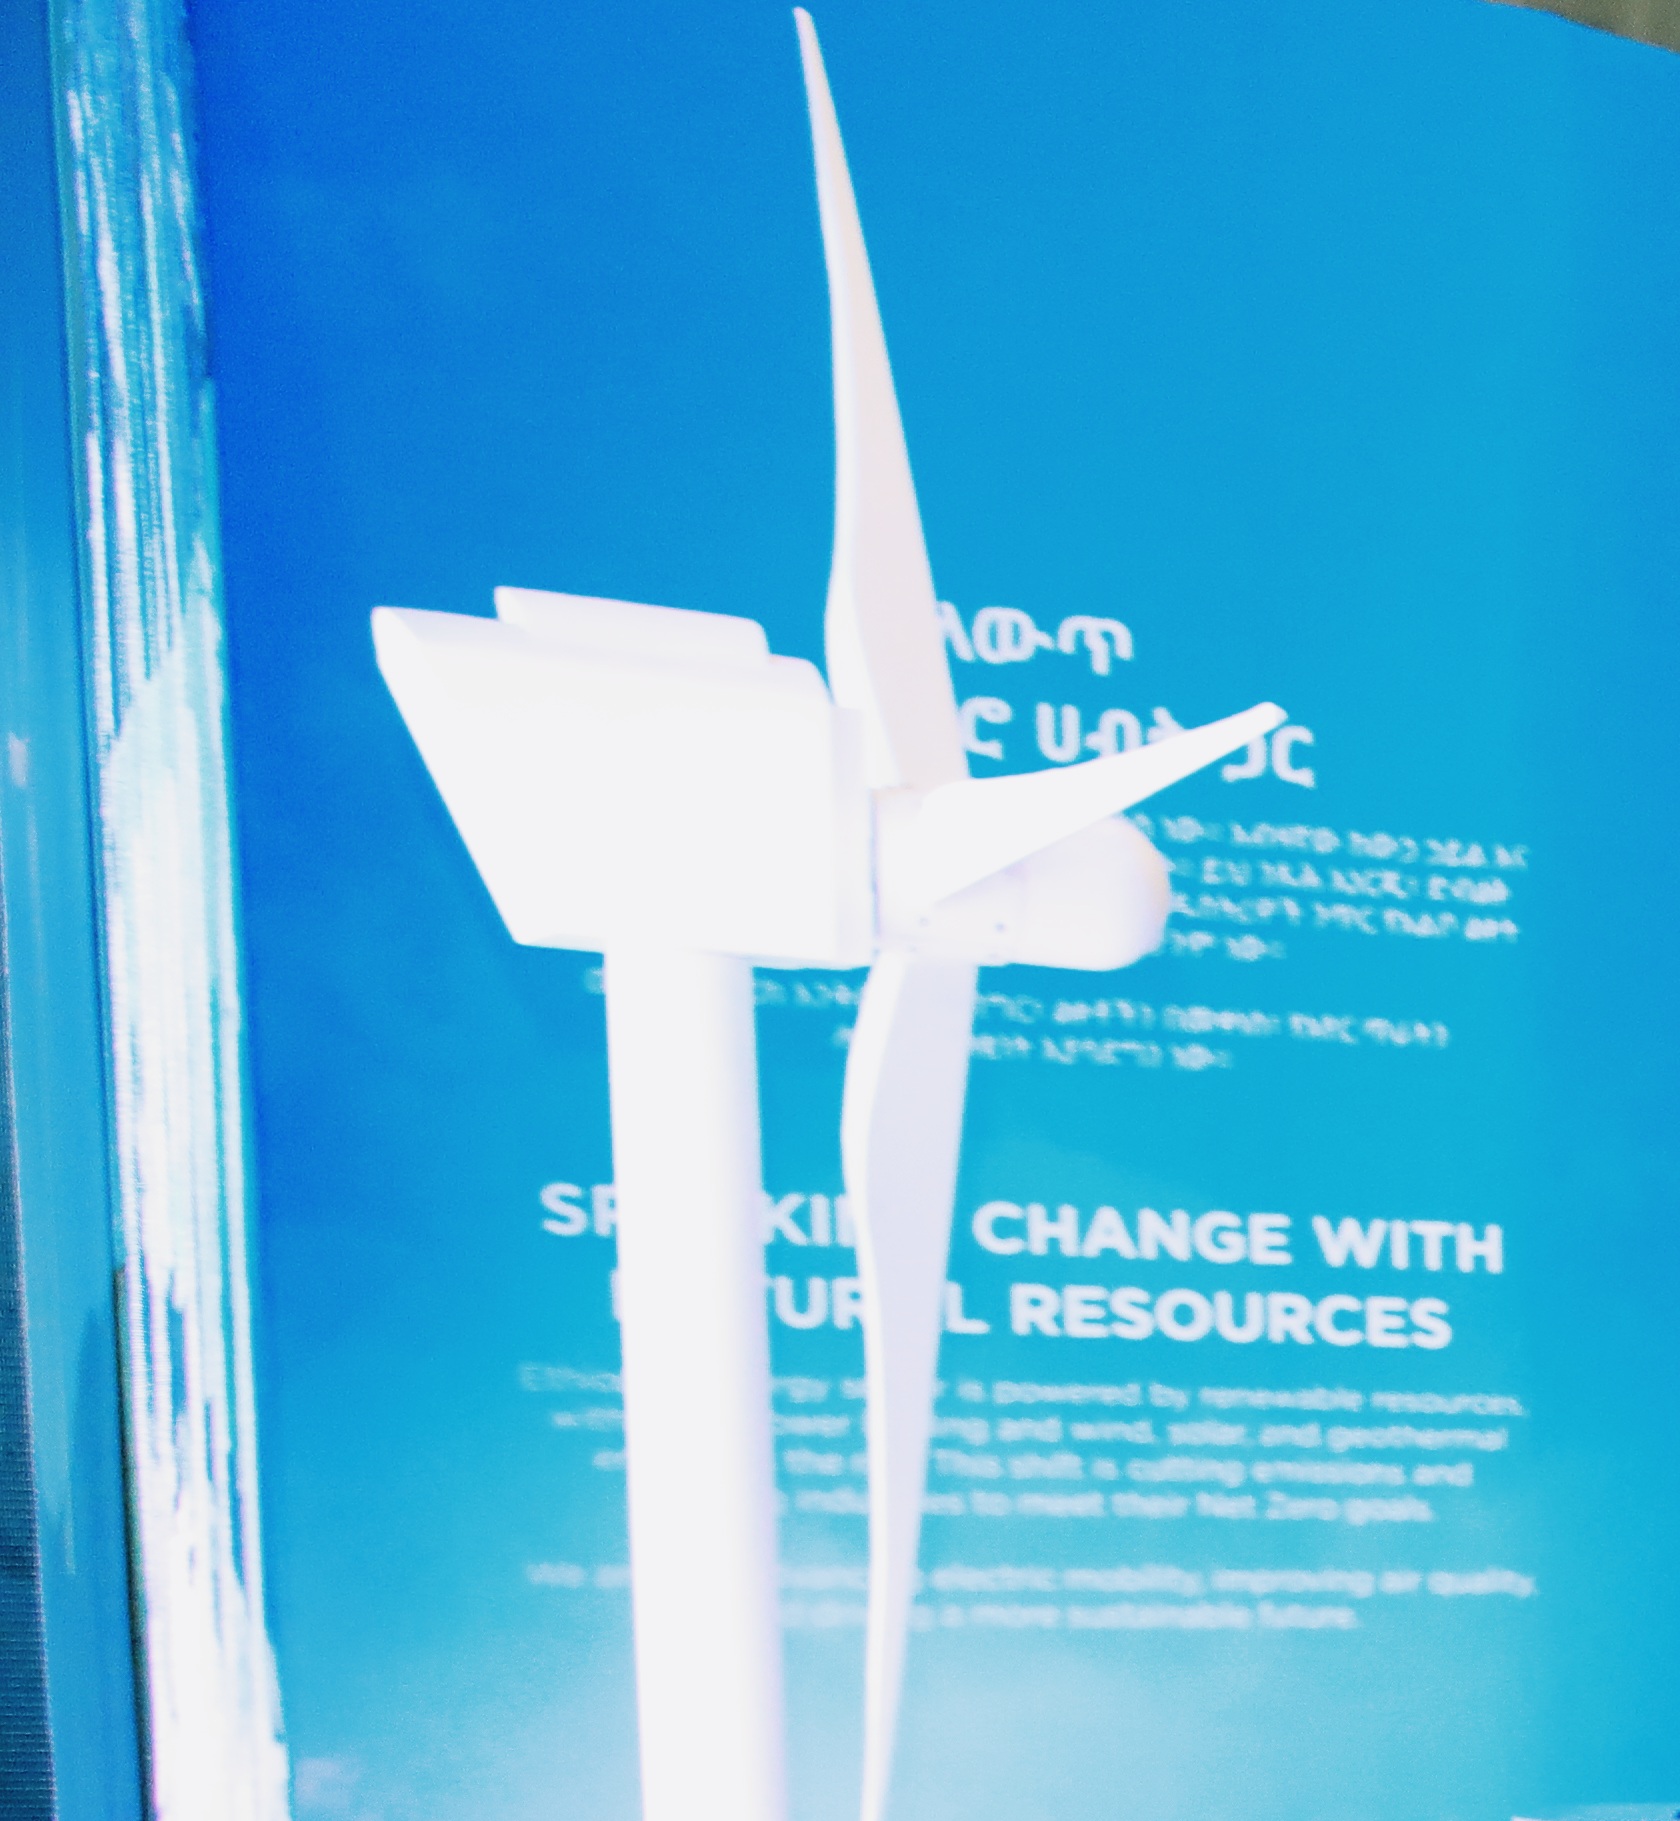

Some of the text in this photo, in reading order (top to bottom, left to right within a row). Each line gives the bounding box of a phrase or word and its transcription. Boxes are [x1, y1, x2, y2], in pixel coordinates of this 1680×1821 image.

[540, 1182, 1503, 1275] SPKI CHANGE WITH
[1010, 1282, 1454, 1350] RESOURCES
